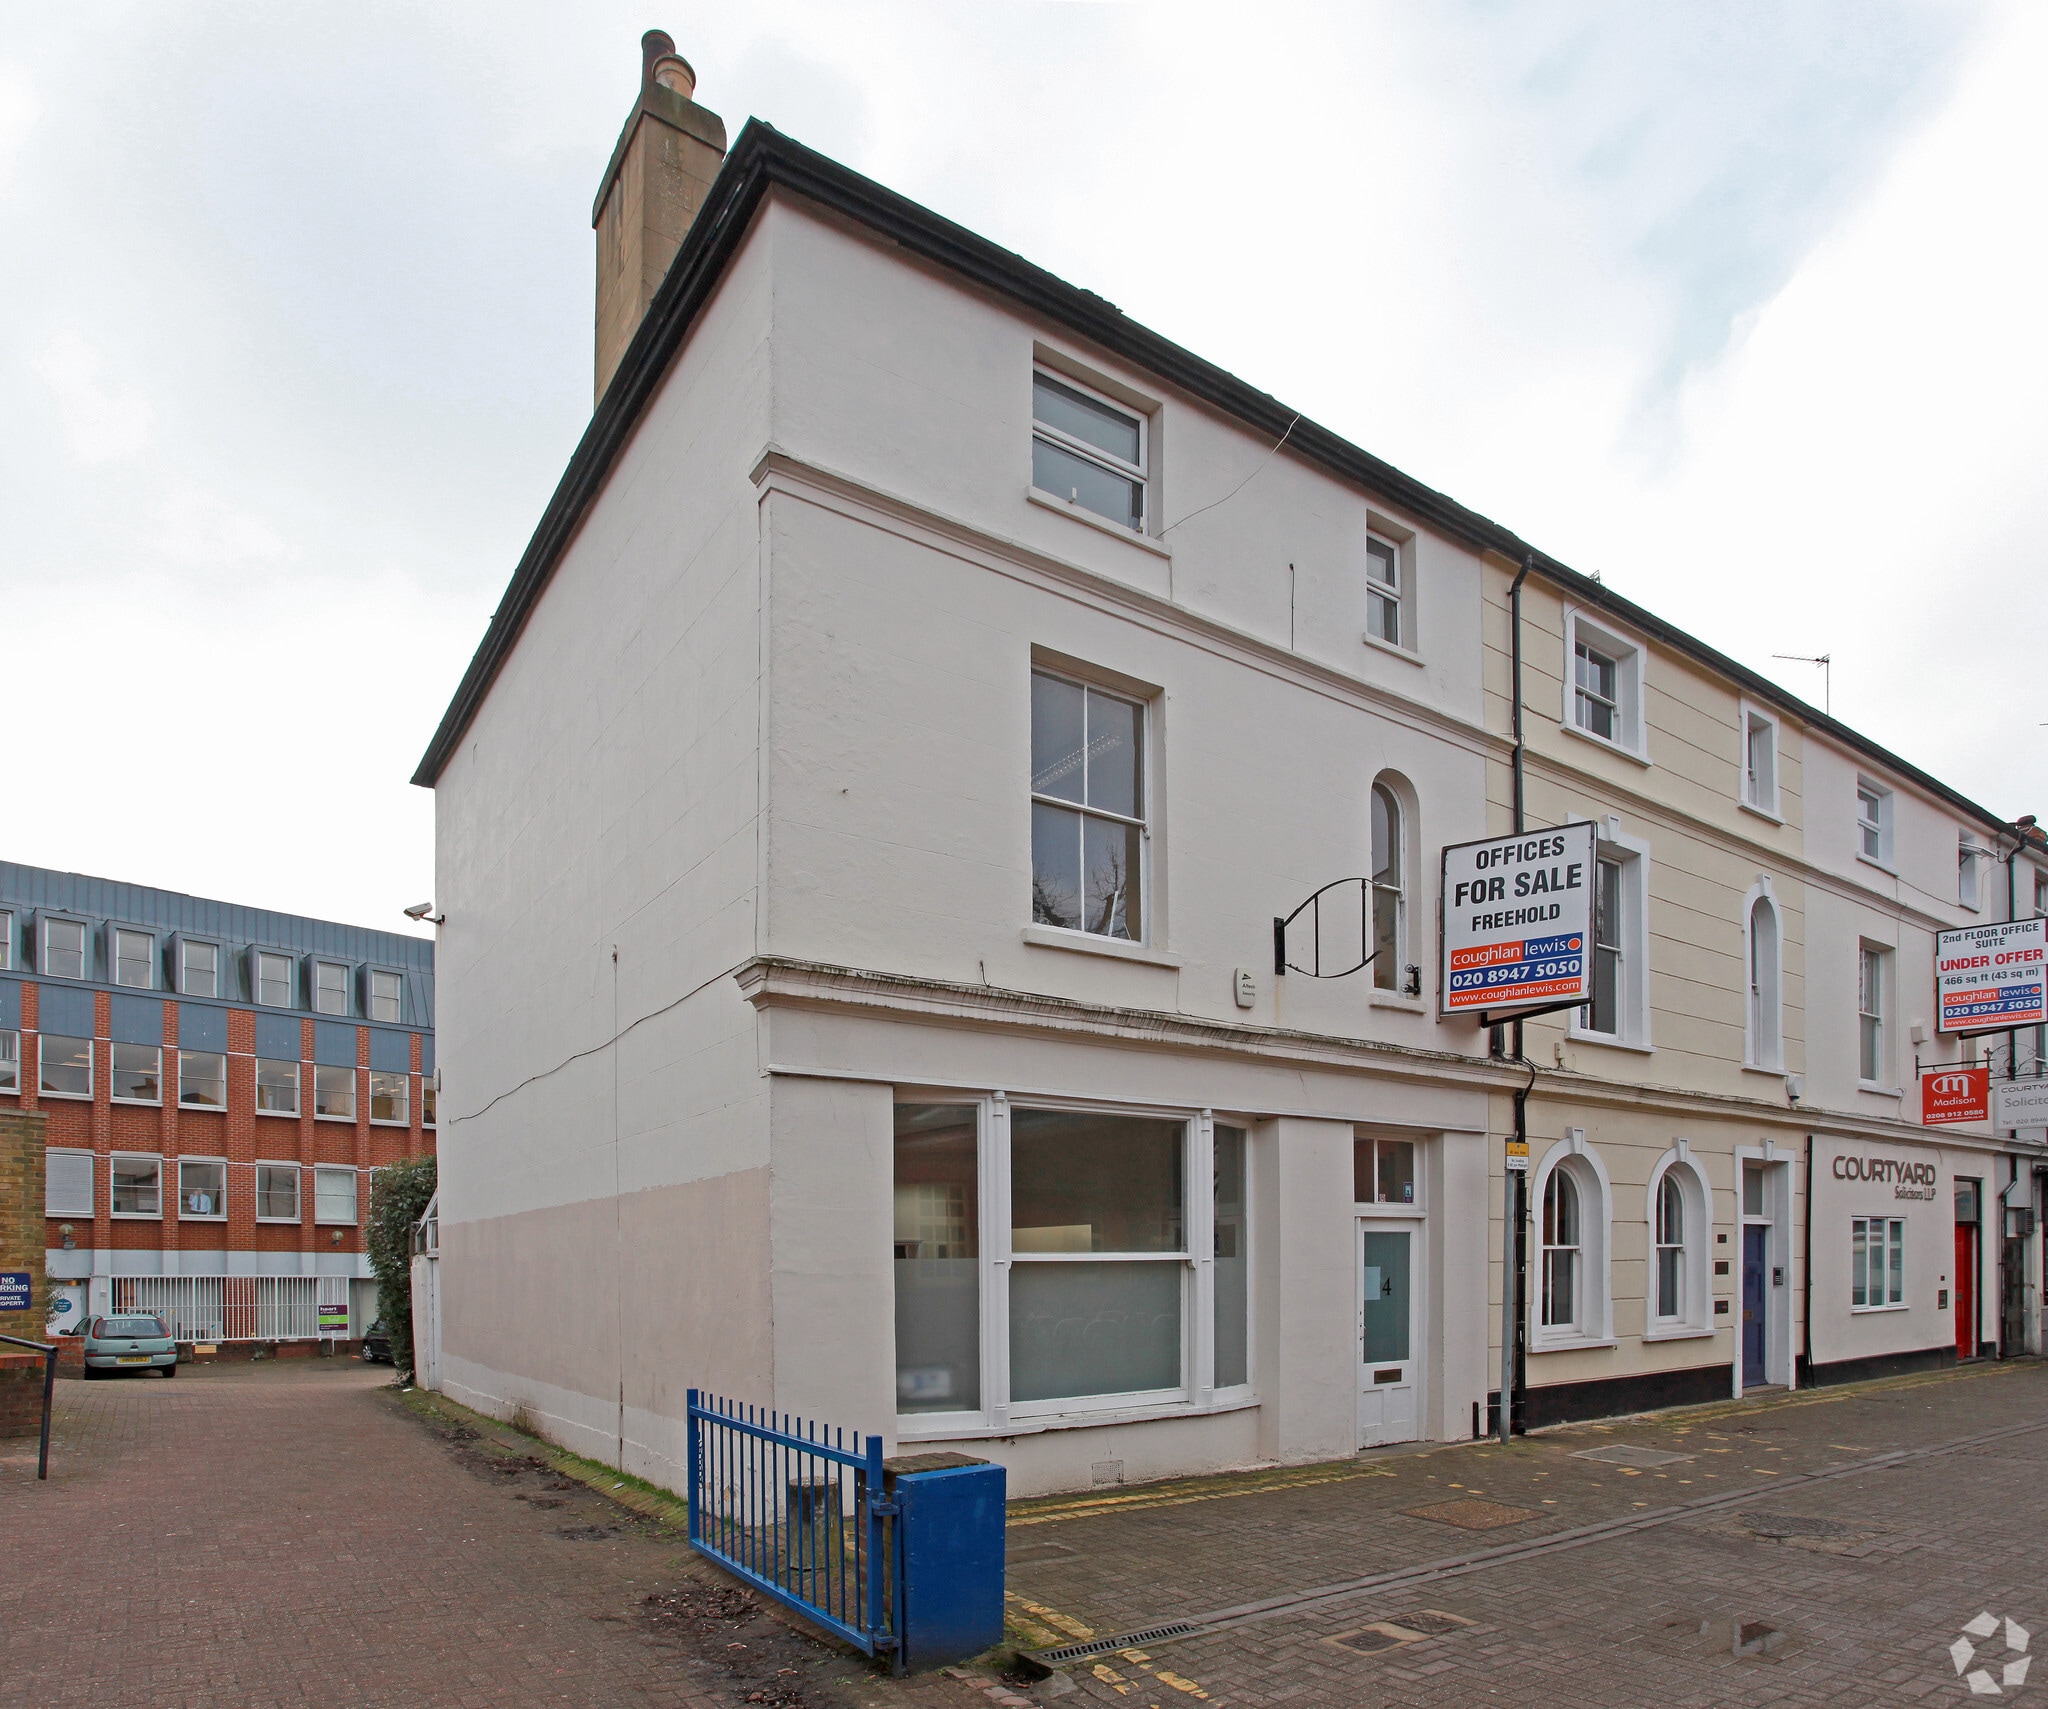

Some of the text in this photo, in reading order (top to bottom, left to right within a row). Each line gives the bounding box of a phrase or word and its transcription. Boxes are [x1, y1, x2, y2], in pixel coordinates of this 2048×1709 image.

[1475, 836, 1565, 870] OFFICES
[1455, 863, 1582, 908] FOR SALE
[1472, 903, 1561, 932] FREEHOLD
[1942, 922, 2039, 944] 2nd FLOOR OFFICE
[1975, 937, 2005, 949] SUITE
[1453, 938, 1566, 965] coughlan lewis
[1940, 948, 2043, 972] UNDER OFFER
[1452, 959, 1580, 988] 020 8947 5050
[1944, 967, 2039, 986] 466 sq ft (43 sq m)
[1451, 981, 1580, 1004] www.coughlanlewis.com
[1944, 986, 2030, 1004] coughlan lewis
[1945, 999, 2041, 1017] 020 8947 5050
[1945, 1011, 2041, 1026] www.coughlanlewis.com
[1933, 1096, 1976, 1107] Madison
[1832, 1155, 1936, 1186] COURTYARD
[1894, 1185, 1937, 1201] Solicitors LLP
[1, 1276, 15, 1284] NO
[1382, 1277, 1392, 1296] 4
